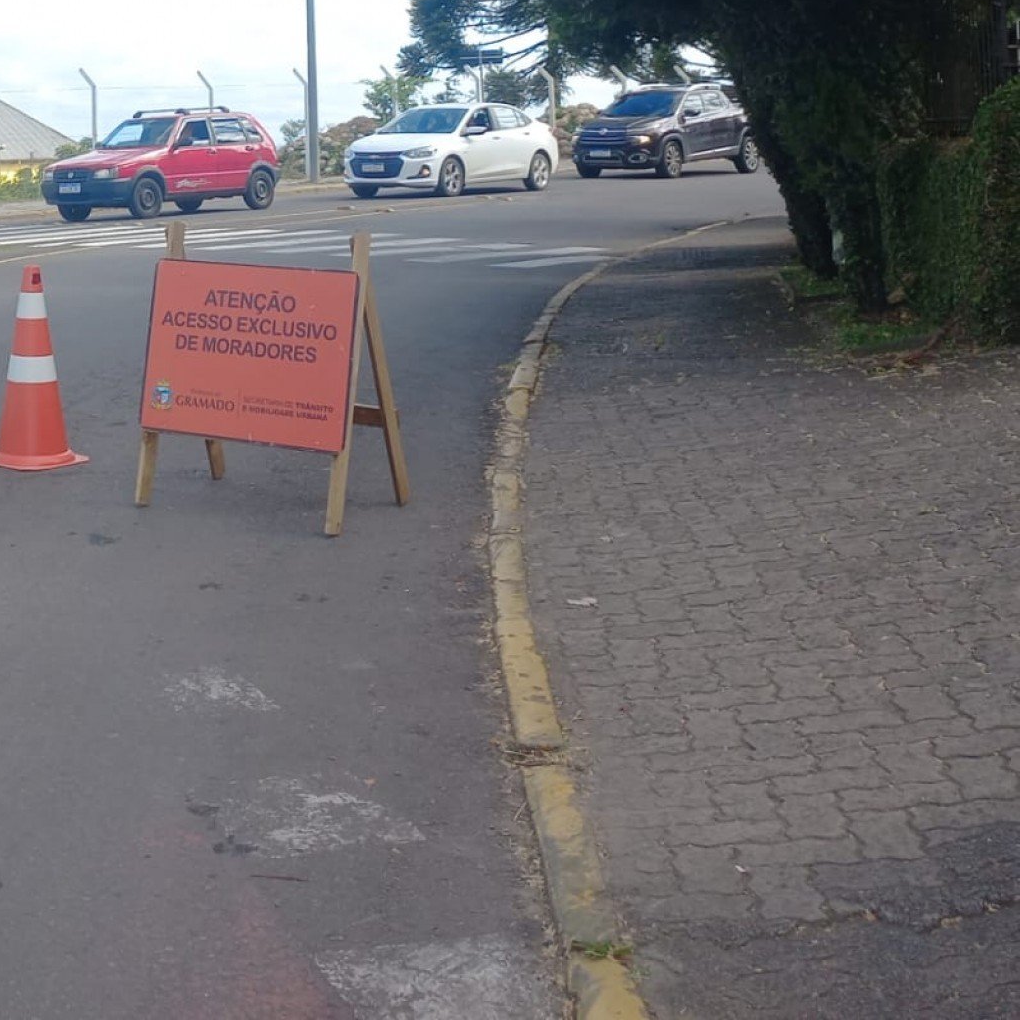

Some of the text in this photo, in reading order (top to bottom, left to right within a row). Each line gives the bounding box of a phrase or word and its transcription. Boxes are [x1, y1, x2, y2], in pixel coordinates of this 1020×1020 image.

[204, 289, 296, 314] ATENÇÃO
[162, 311, 337, 341] ACESSO EXCLUSIVO
[175, 334, 317, 363] DE MORADORES
[175, 395, 235, 412] GRAMADO
